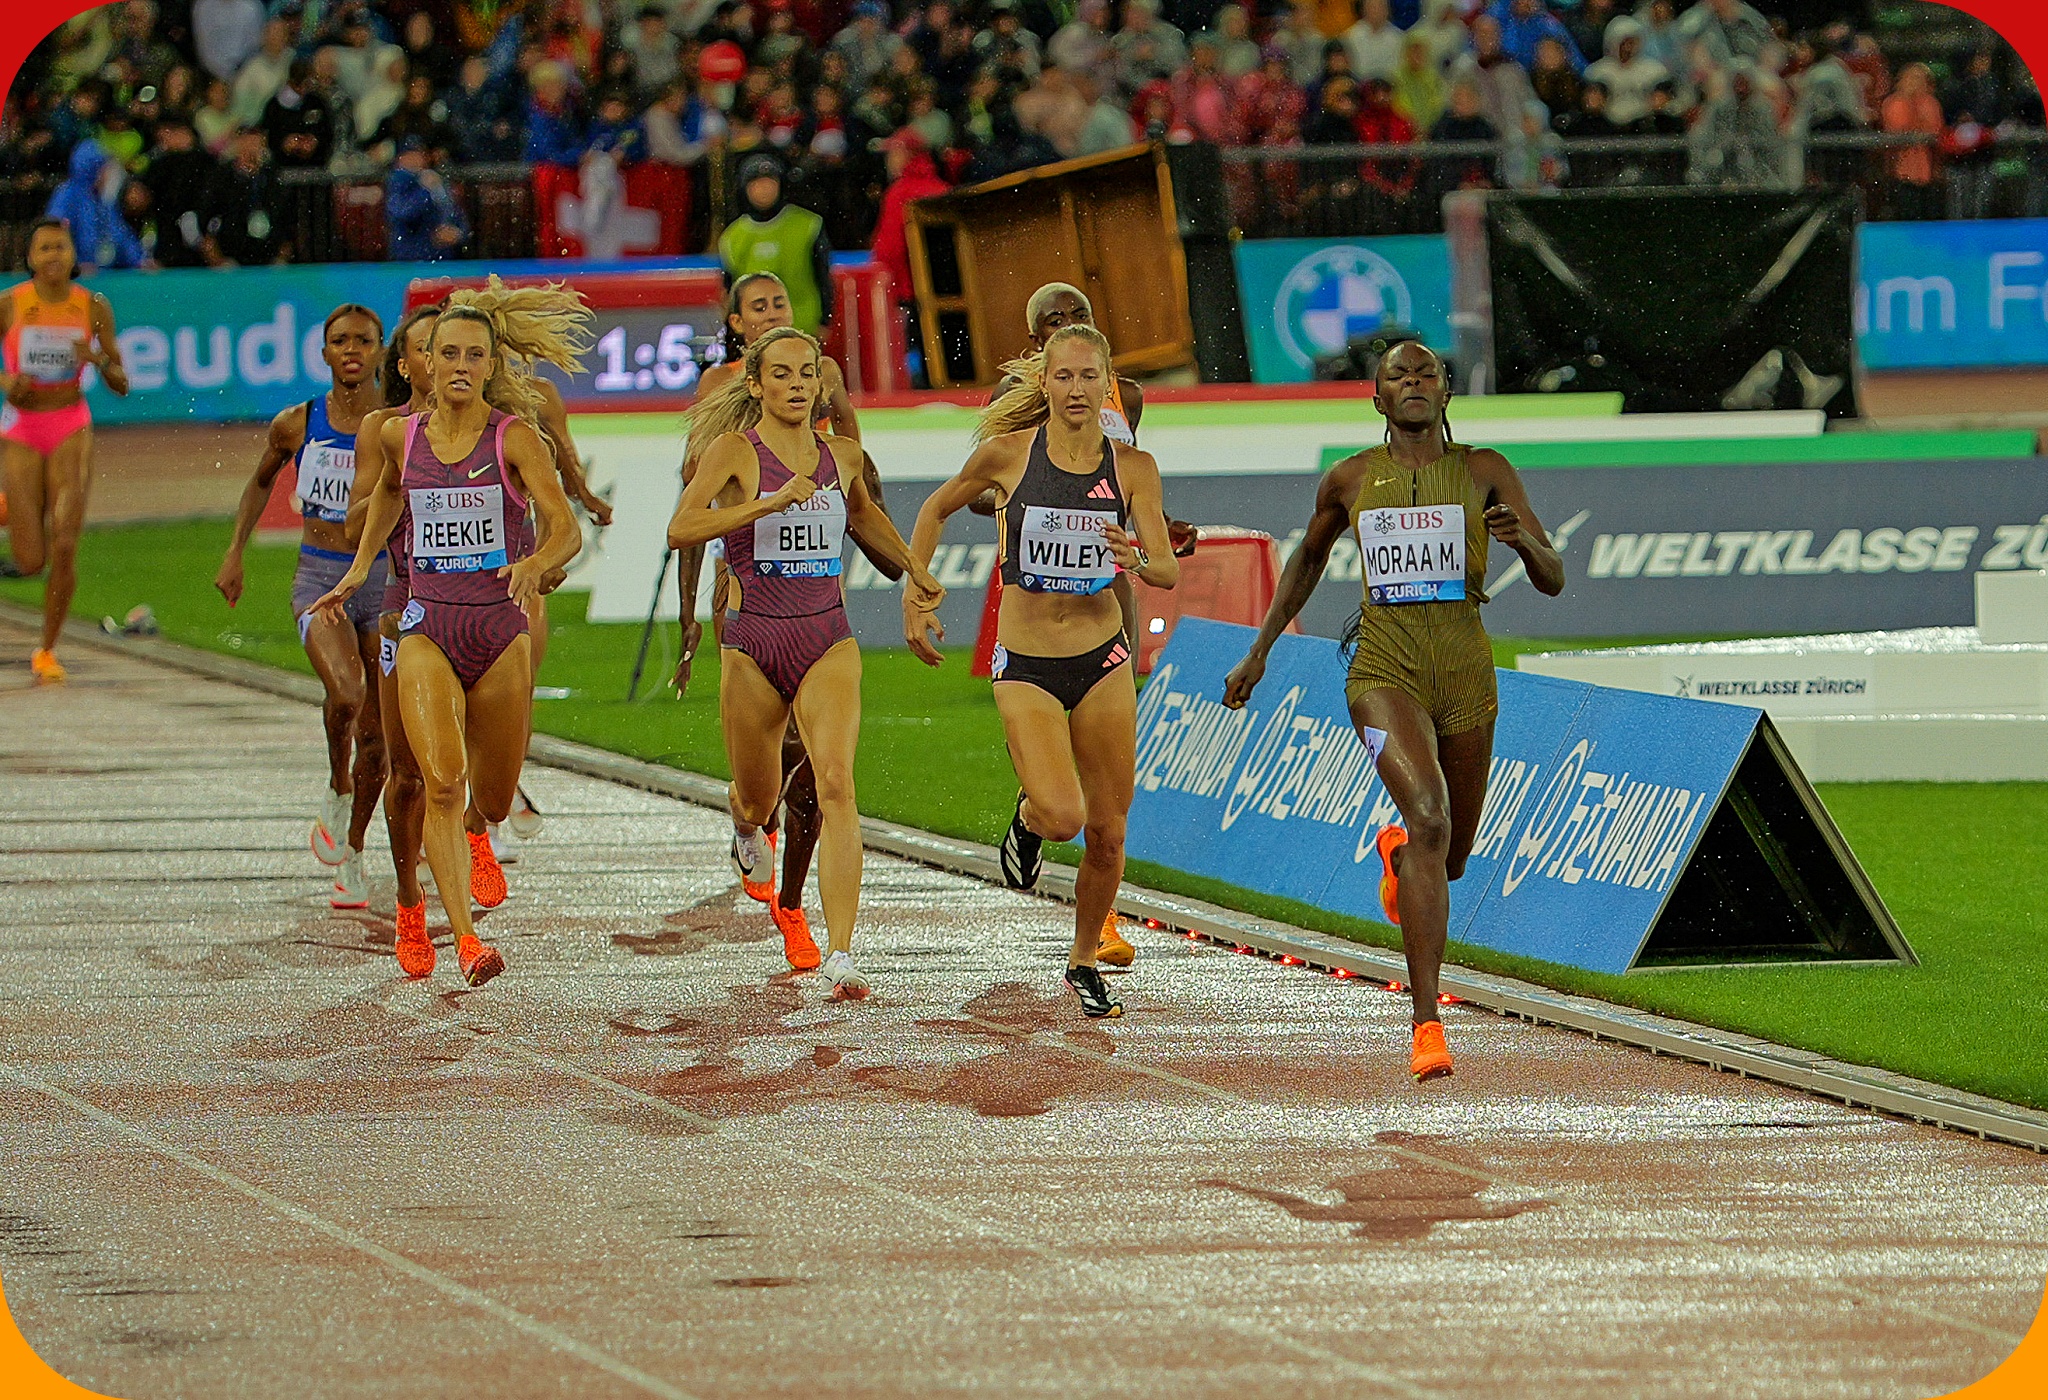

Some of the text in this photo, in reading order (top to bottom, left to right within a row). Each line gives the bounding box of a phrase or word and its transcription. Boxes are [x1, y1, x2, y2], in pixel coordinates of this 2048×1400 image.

[1988, 250, 2048, 331] F
[447, 492, 485, 509] UBS
[799, 495, 831, 512] UBS
[1066, 514, 1105, 533] UBS
[1398, 510, 1443, 530] UBS
[422, 518, 495, 549] REEKIE
[779, 524, 829, 552] BELL
[1028, 539, 1108, 569] WILEY
[1366, 544, 1434, 577] MORAA
[1440, 542, 1460, 572] M.
[1586, 526, 1980, 579] WELTKLASSE
[435, 556, 482, 571] ZURICH
[781, 560, 829, 575] ZURICH
[1041, 577, 1091, 593] ZURICH
[1385, 583, 1438, 600] ZURICH
[1698, 676, 1867, 697] WELTKLASSE ZÜRICH
